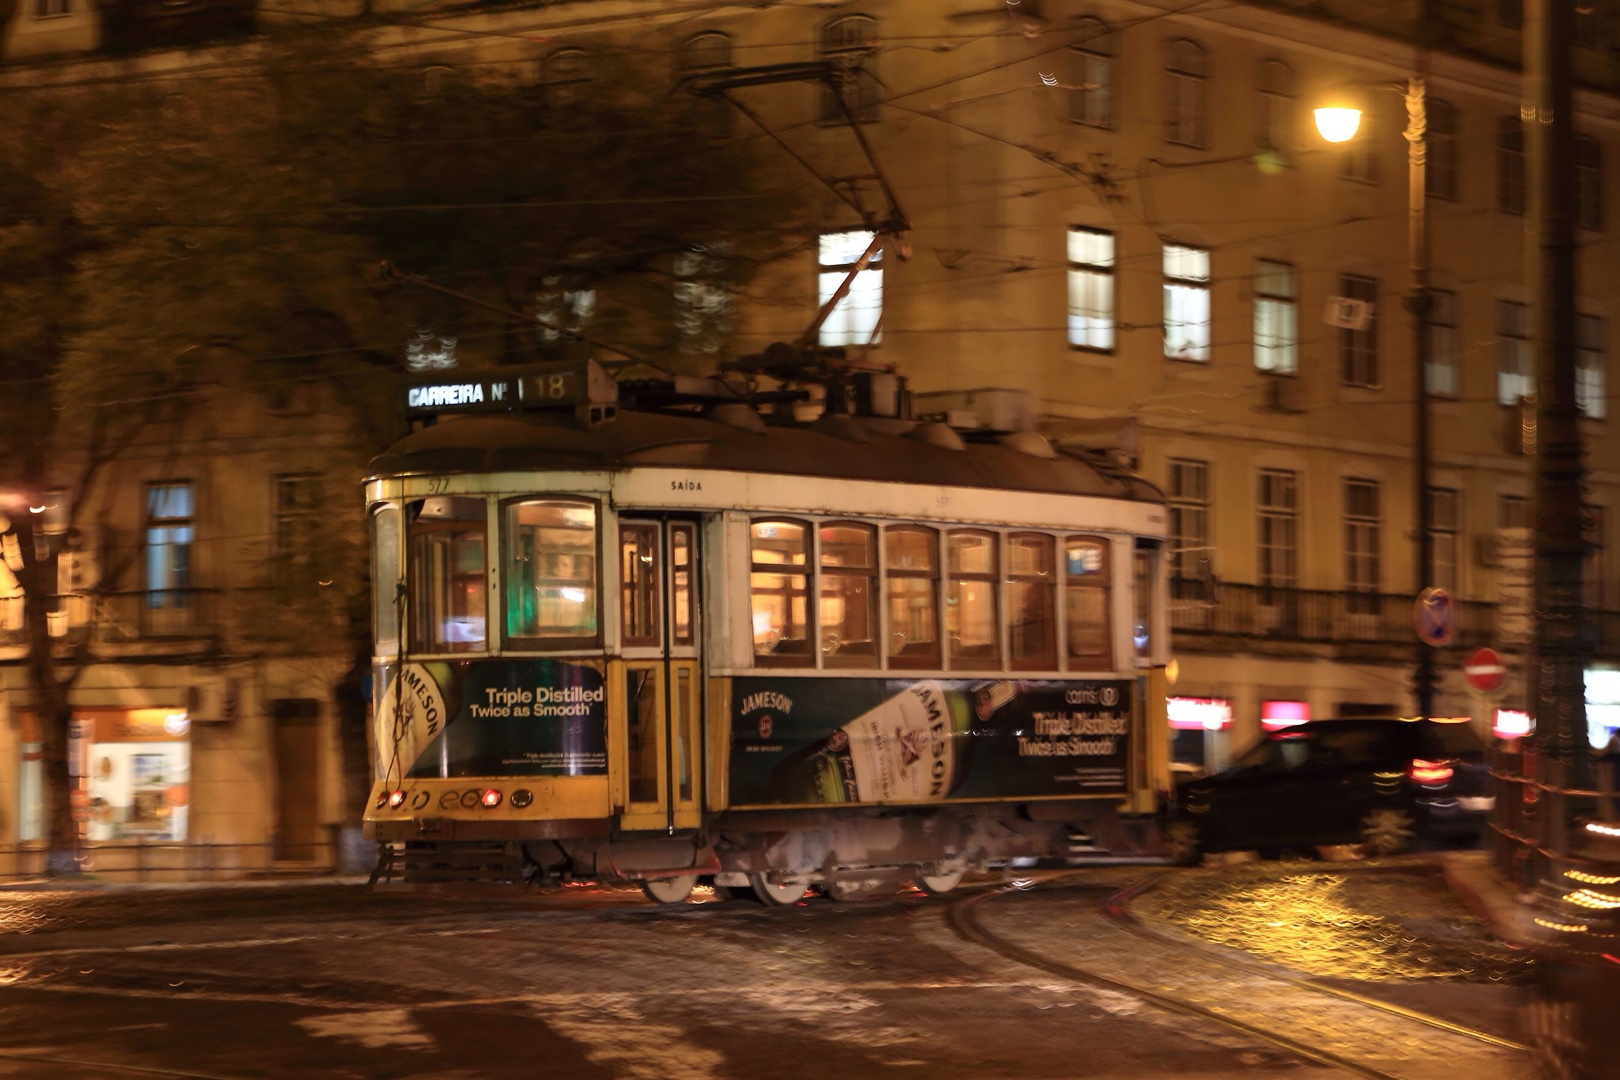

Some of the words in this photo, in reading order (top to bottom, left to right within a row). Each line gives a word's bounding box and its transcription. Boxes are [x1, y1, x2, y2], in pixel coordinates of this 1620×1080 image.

[408, 382, 484, 407] CARREIRA
[535, 375, 565, 399] 18
[428, 474, 450, 494] 577
[670, 479, 702, 491] SAÍDA
[396, 669, 438, 736] AMESON
[485, 687, 532, 706] Triple
[536, 686, 604, 703] Distilled
[740, 690, 793, 716] JAMESON
[469, 704, 511, 718] Twice
[513, 706, 530, 717] as
[910, 685, 946, 796] JAMESON
